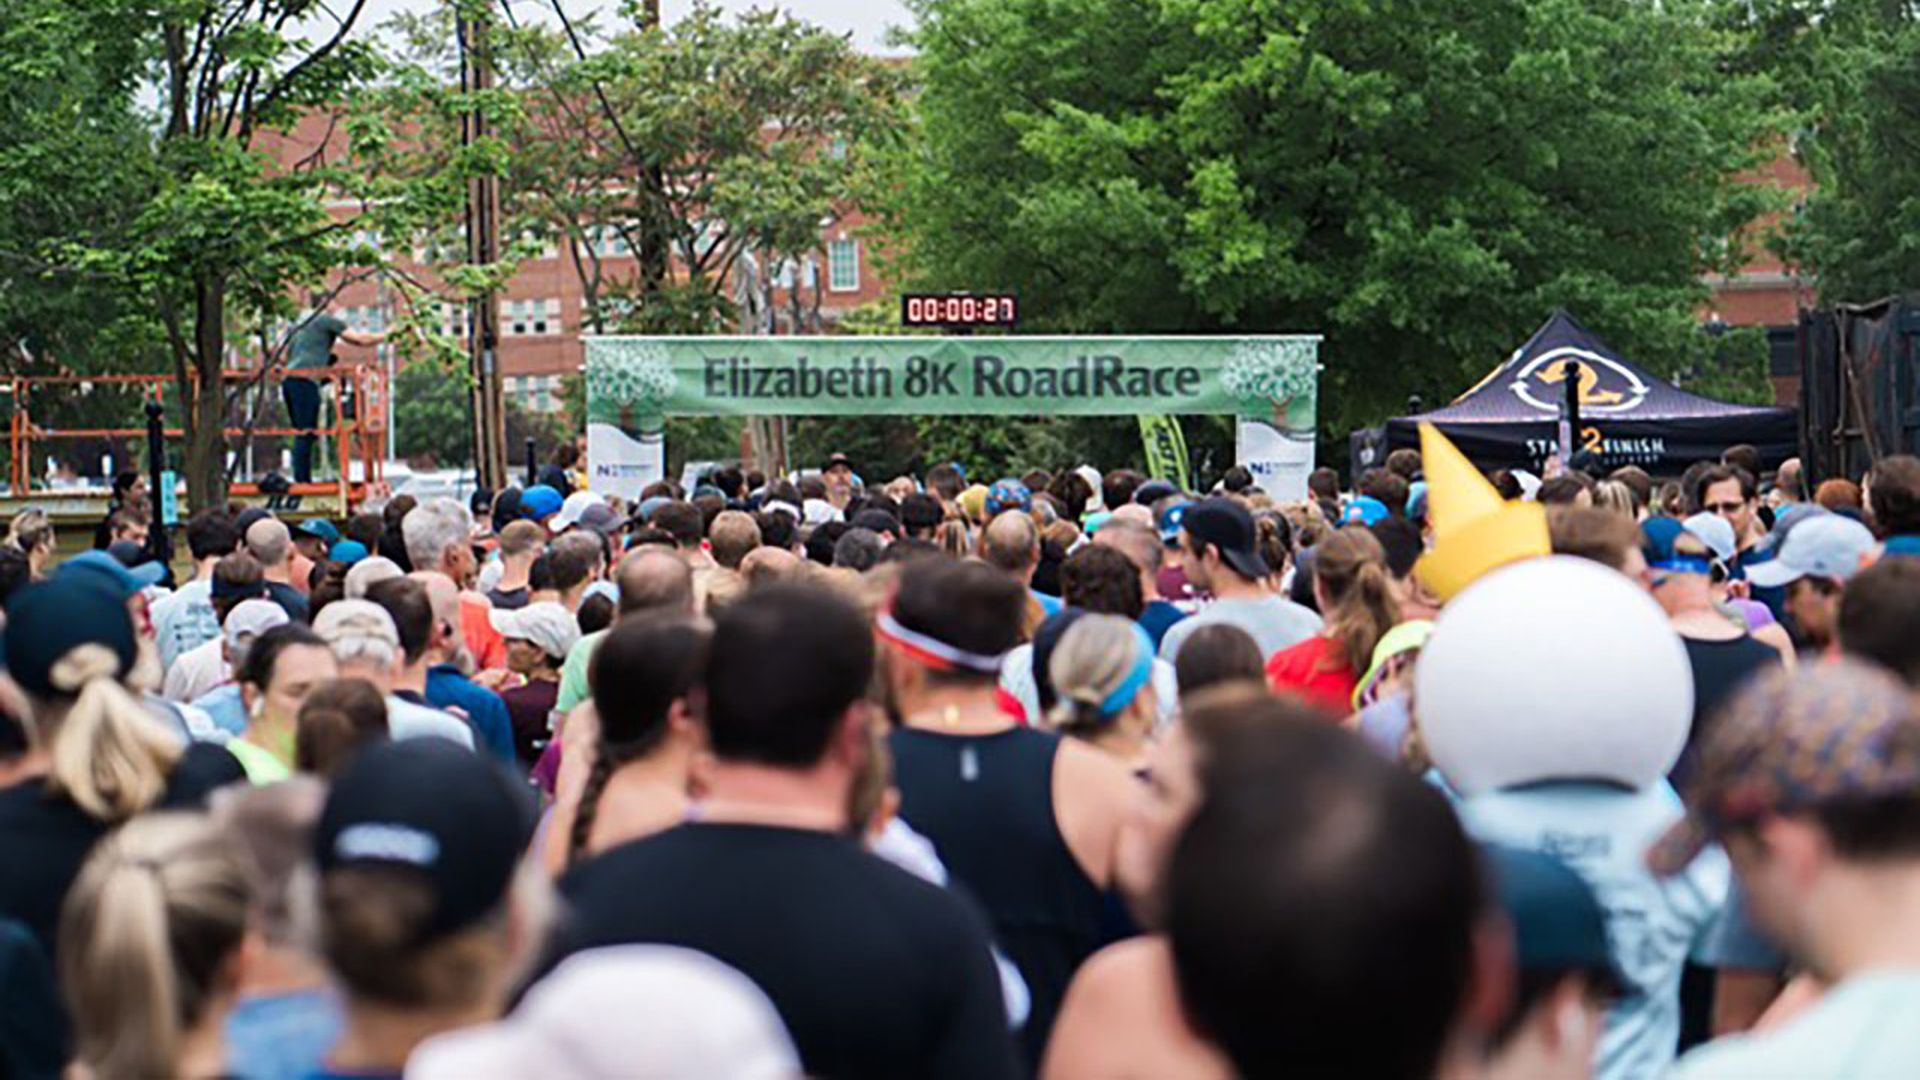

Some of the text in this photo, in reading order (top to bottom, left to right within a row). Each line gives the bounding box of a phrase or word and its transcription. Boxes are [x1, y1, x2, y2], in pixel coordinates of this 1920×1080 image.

[908, 298, 1013, 321] 00:00:27
[704, 357, 893, 398] Elizabeth
[973, 355, 1201, 397] RoadRace
[1603, 438, 1666, 453] FINISH
